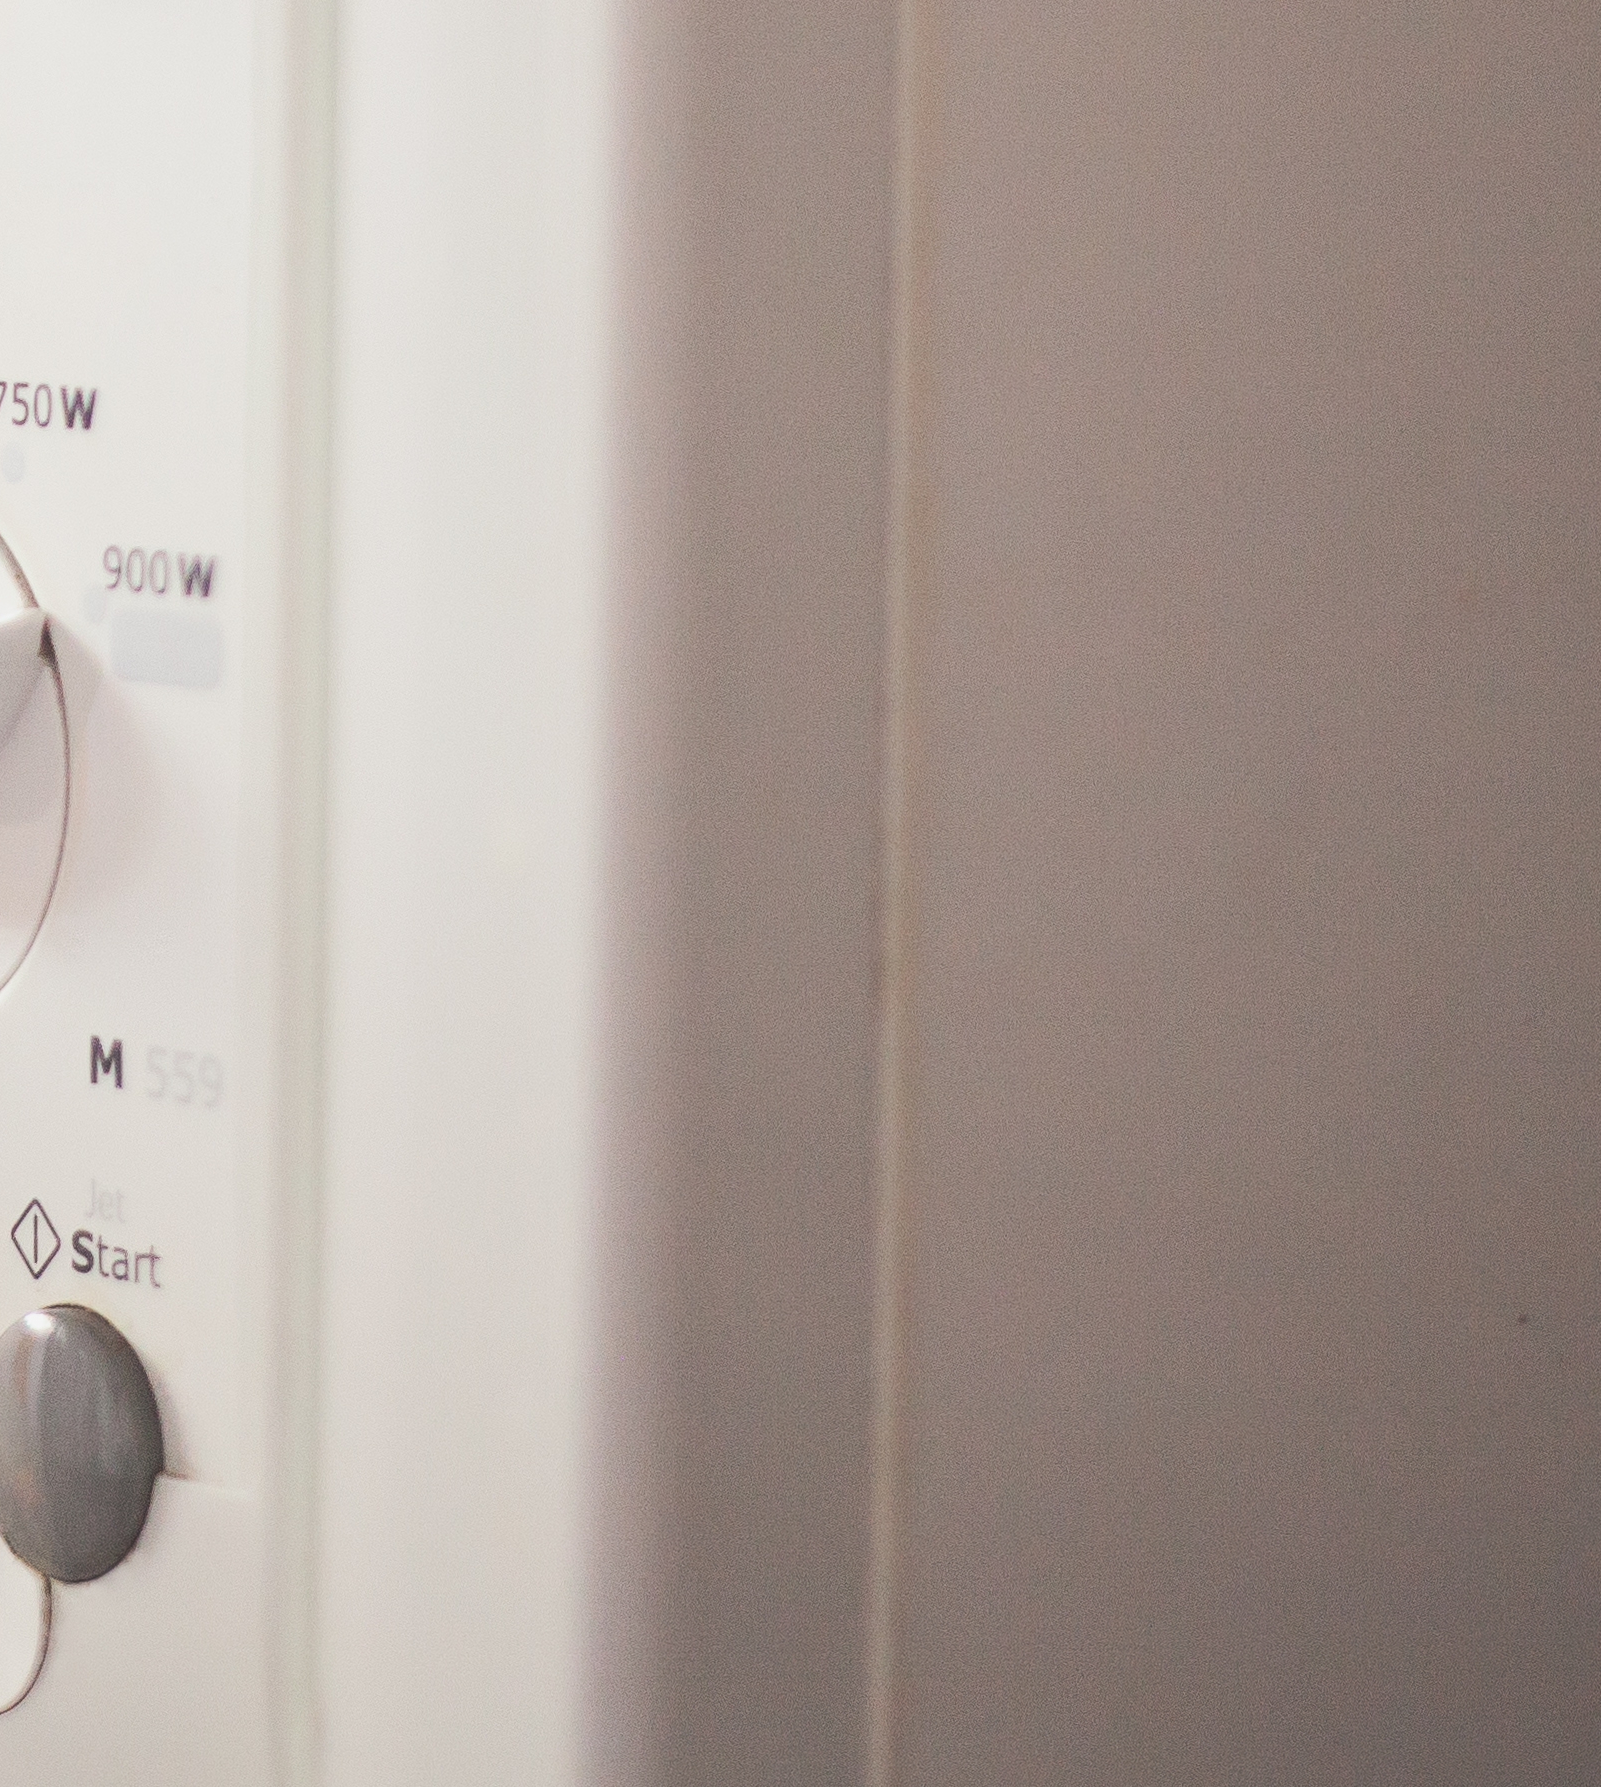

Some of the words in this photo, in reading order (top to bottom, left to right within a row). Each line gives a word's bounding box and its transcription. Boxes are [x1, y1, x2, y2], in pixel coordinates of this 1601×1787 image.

[88, 1034, 124, 1090] M
[145, 1044, 226, 1111] 559
[83, 1177, 127, 1225] Jet
[70, 1229, 163, 1289] Start
